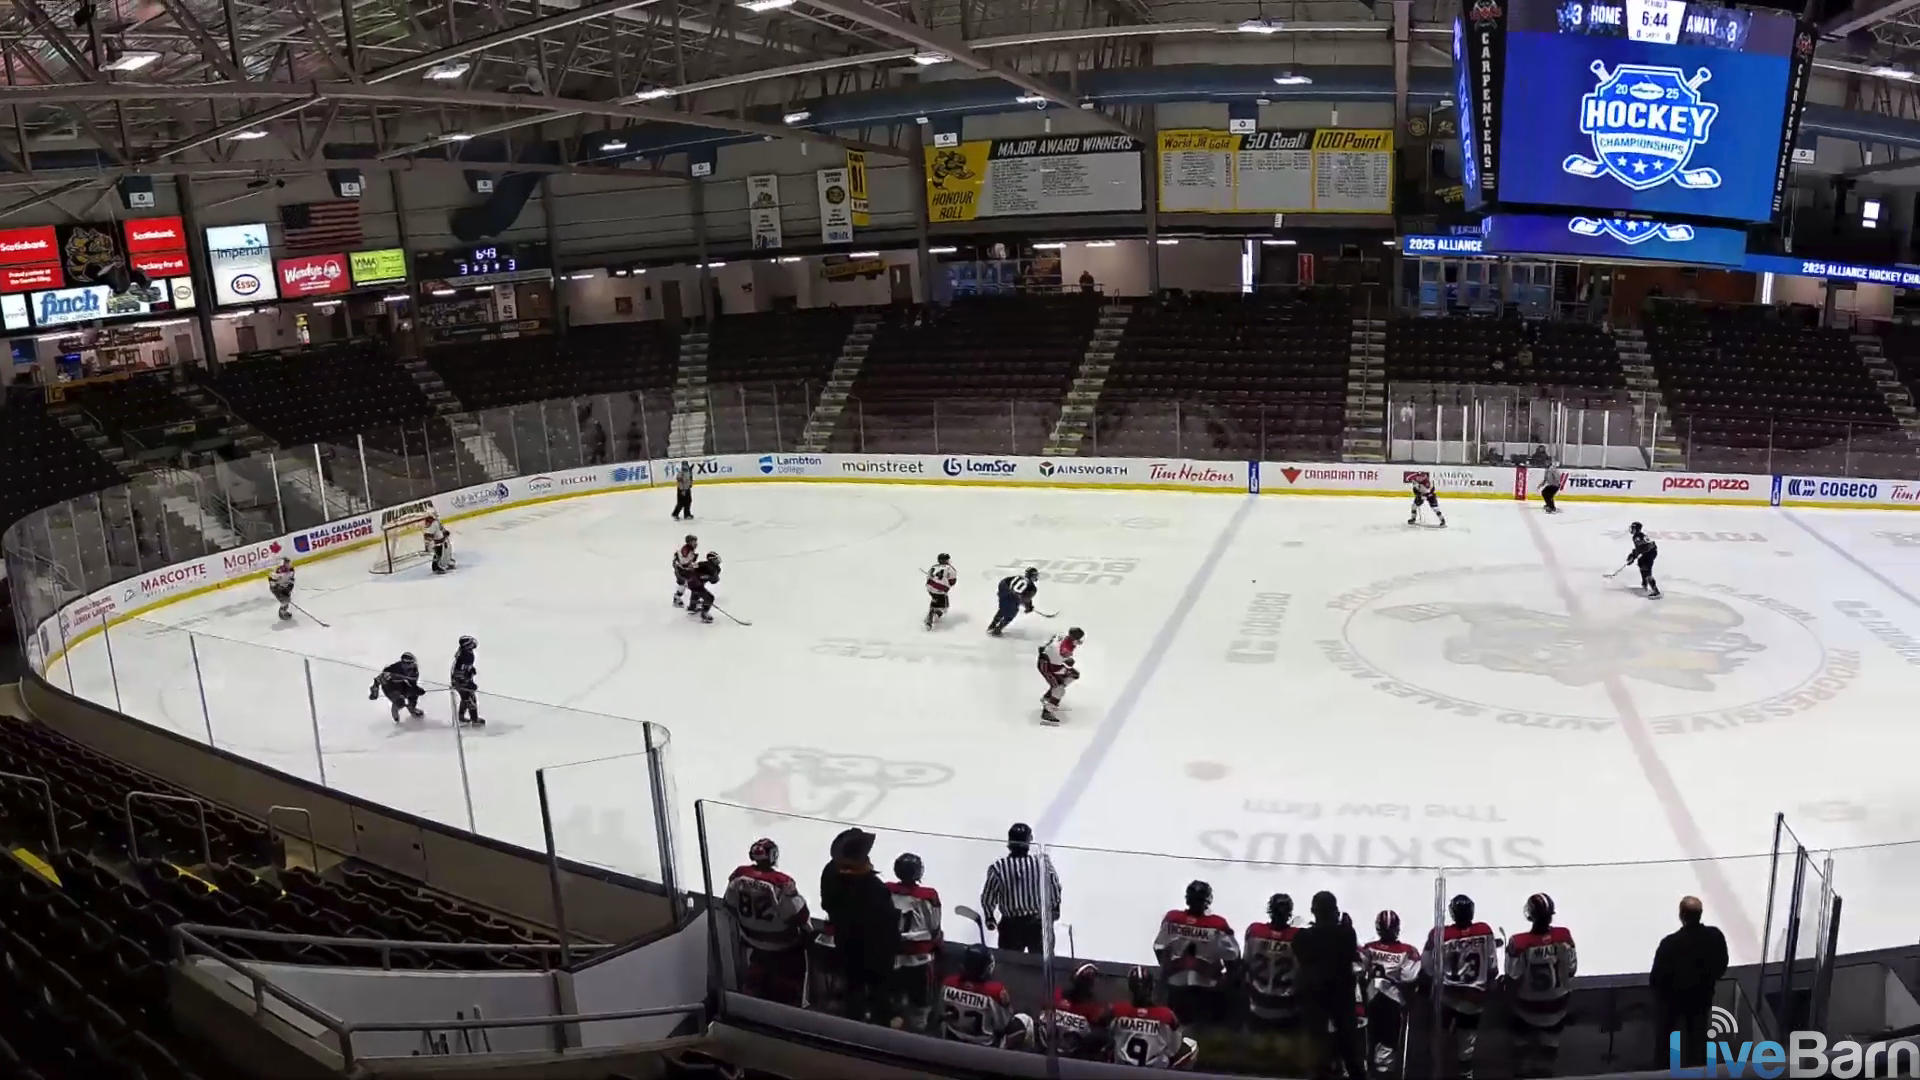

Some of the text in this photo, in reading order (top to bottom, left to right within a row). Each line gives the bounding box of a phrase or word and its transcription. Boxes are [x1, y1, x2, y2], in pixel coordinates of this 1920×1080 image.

[1571, 4, 1623, 25] 3 HOME
[1641, 11, 1669, 28] 6:44
[1685, 14, 1738, 42] AWAY 3
[1480, 32, 1493, 169] CARPENTERS
[1615, 84, 1680, 100] 20 25
[1586, 99, 1713, 138] HOCKEY
[1776, 63, 1804, 192] CARPENTERS
[997, 135, 1134, 157] MAJOR AWARD WINNERS
[1164, 136, 1230, 150] World JR Gold
[1246, 132, 1267, 150] 50
[1269, 132, 1301, 150] Goal
[1599, 137, 1685, 156] CHAMPIONSHIPS
[931, 190, 975, 206] HONOUR
[938, 206, 964, 220] ROLL
[1409, 238, 1483, 252] 2025 ALLIANCE
[1802, 261, 1826, 274] 2025
[1826, 264, 1868, 279] ALLIANCE
[1868, 270, 1902, 283] HOCKEY
[37, 288, 100, 325] finch
[777, 456, 822, 466] Lambton
[777, 465, 805, 475] College
[842, 460, 924, 474] mainstreet
[966, 459, 1018, 474] LamSar
[1056, 464, 1128, 477] AINSWORTH
[560, 474, 598, 486] RICOH
[1149, 463, 1177, 480] Tim
[1179, 463, 1235, 482] Hortons
[1304, 469, 1380, 481] CANADIAN TIRE
[1568, 478, 1634, 490] TIRECRAFT
[1662, 477, 1750, 492] pizza pizza
[1819, 481, 1878, 499] COGECO
[1890, 485, 1914, 500] Tim
[309, 517, 373, 541] REAL CANADIAN
[310, 525, 374, 550] SUPERSTORE
[223, 547, 270, 569] Maple
[140, 562, 208, 593] MARCOTTE
[1008, 575, 1028, 595] 10
[1336, 803, 1411, 822] law
[1424, 803, 1508, 823] The
[1197, 828, 1547, 877] SISKINDS
[738, 890, 774, 922] 82
[946, 987, 985, 1008] MARTIN
[1120, 1017, 1161, 1034] MARTIN
[1126, 1036, 1150, 1067] 9
